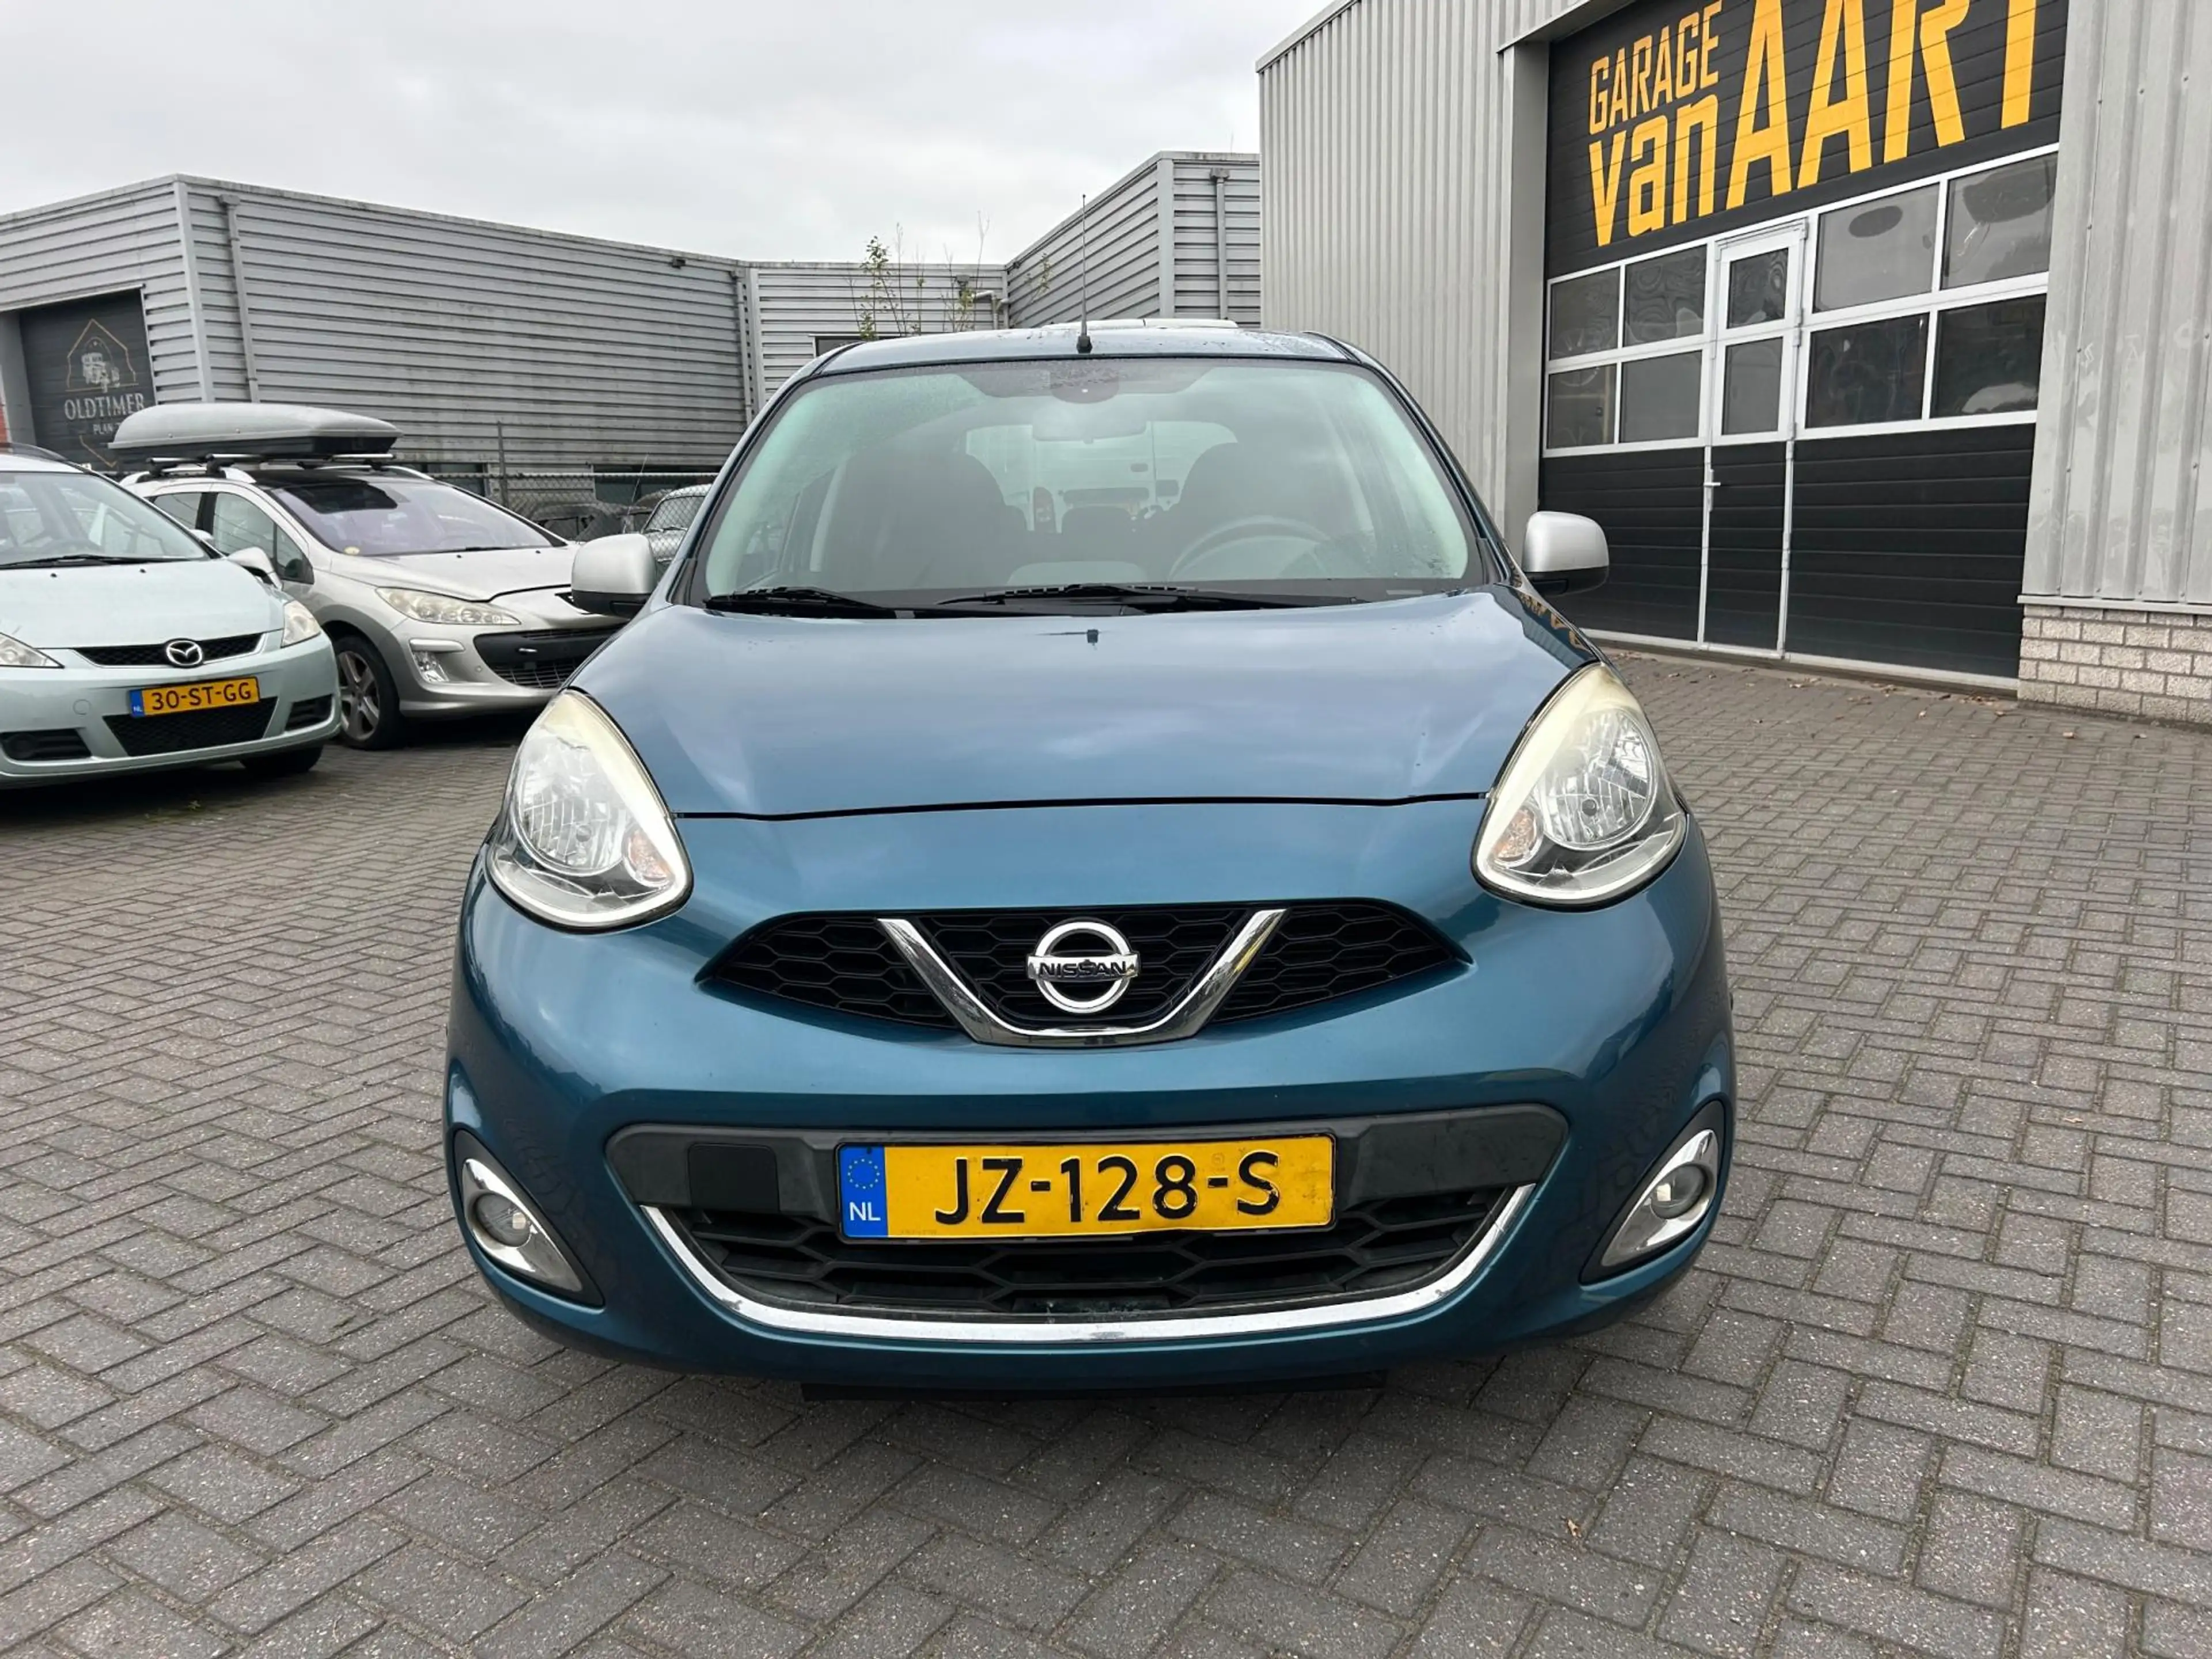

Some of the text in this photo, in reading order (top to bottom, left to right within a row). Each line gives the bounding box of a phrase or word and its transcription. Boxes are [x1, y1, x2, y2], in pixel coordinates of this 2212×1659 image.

[1589, 0, 1722, 135] GARAGE
[1589, 94, 1718, 247] van
[65, 393, 144, 420] OLDTIMER
[151, 682, 252, 710] 30-ST-GG
[1039, 959, 1127, 978] NISSAN
[934, 1150, 1281, 1225] JZ-128-S
[849, 1202, 881, 1221] NL
